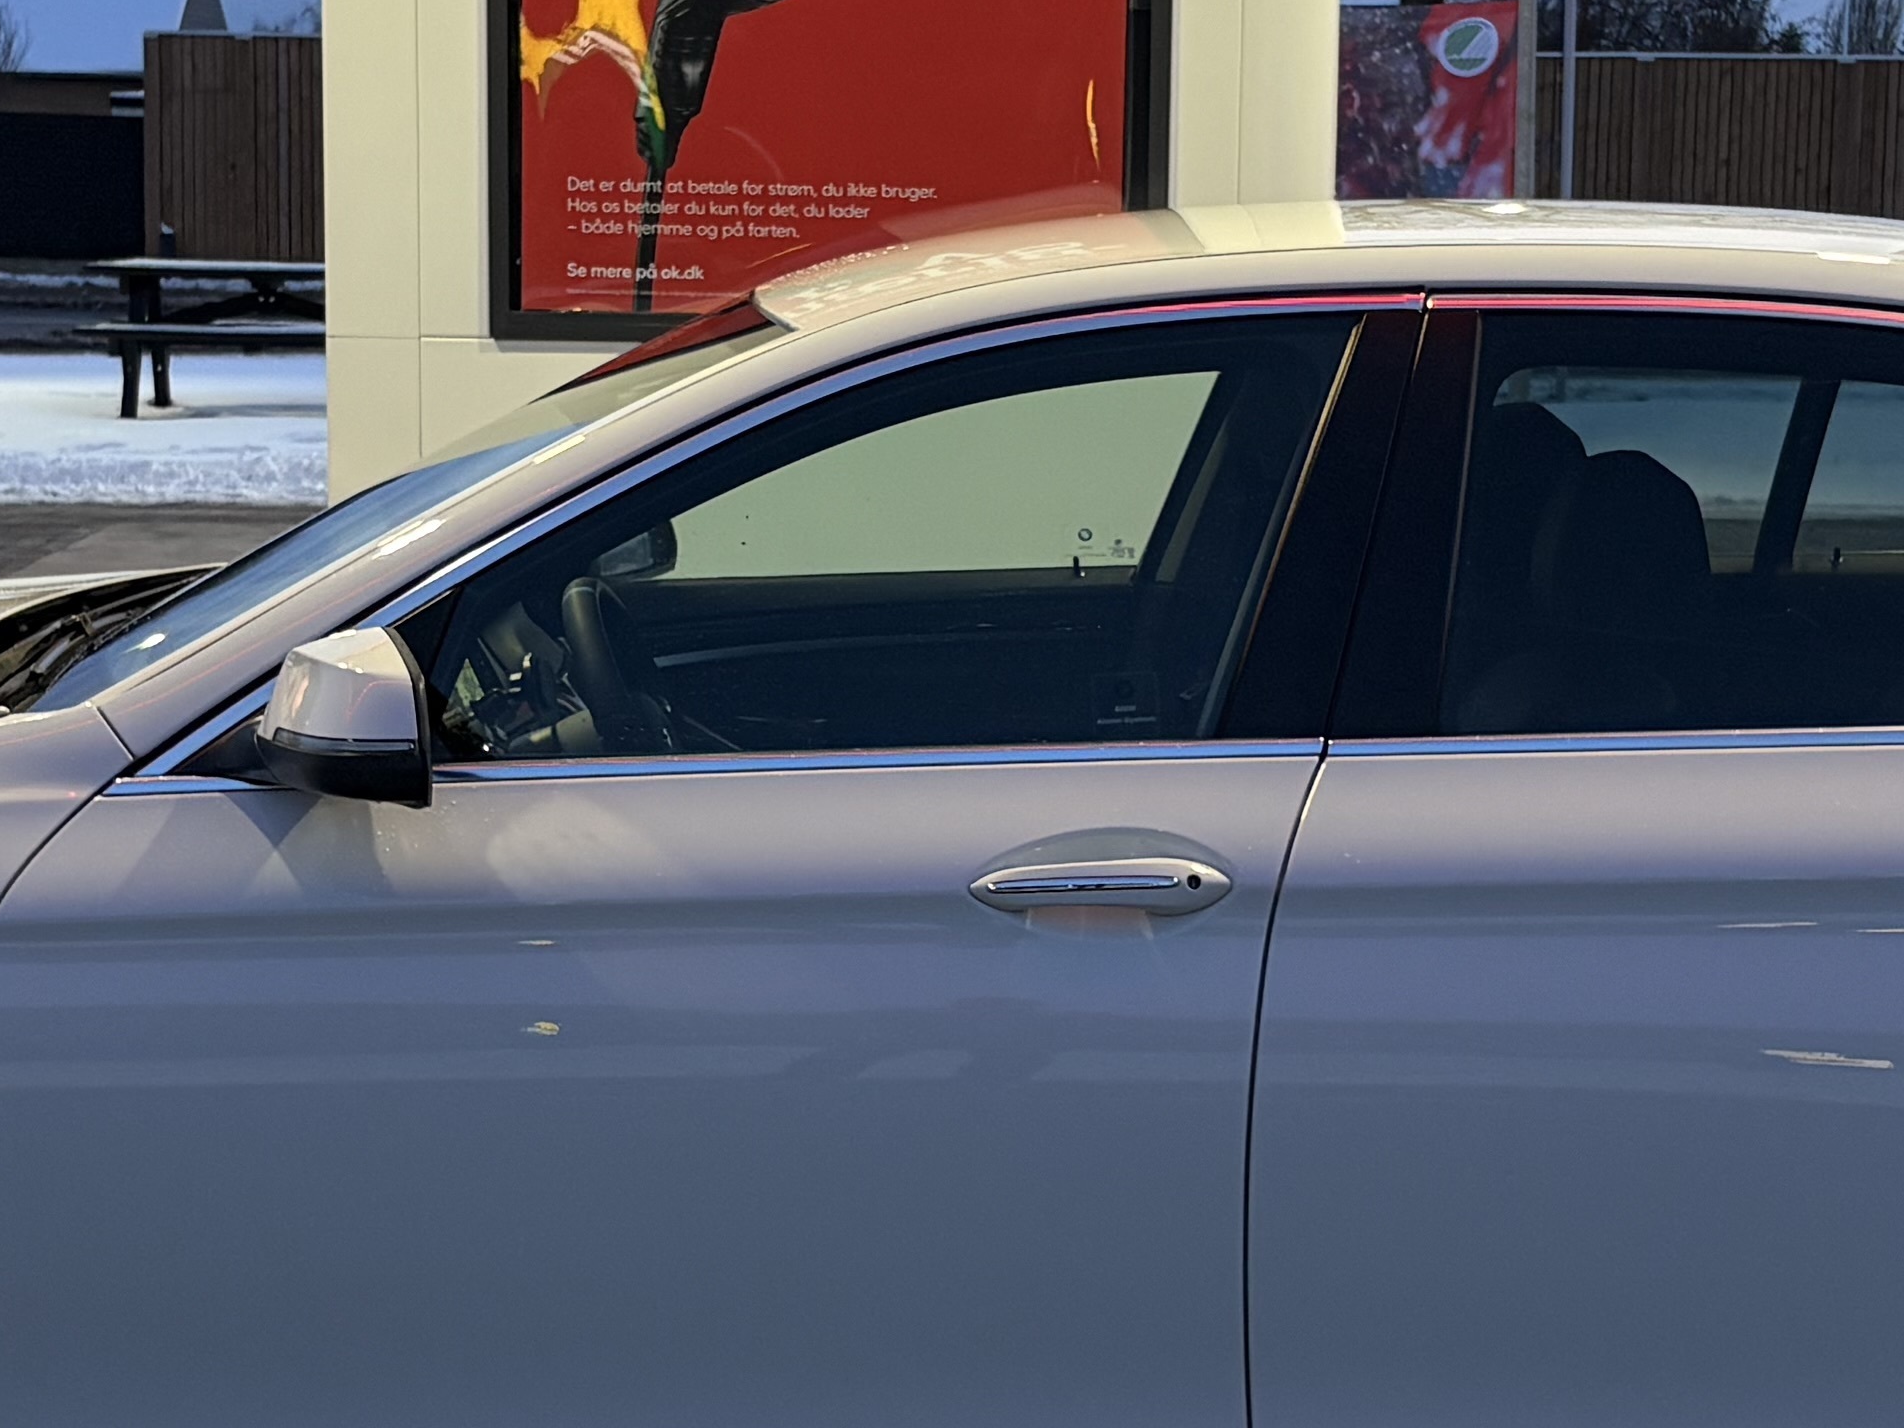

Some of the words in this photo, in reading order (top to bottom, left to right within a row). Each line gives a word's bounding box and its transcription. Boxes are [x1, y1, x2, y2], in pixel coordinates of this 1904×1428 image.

[567, 176, 595, 192] Det
[599, 180, 616, 193] er
[620, 178, 662, 194] dumt
[666, 180, 684, 194] at
[688, 180, 738, 195] betale
[742, 180, 764, 196] for
[768, 182, 818, 198] strøm,
[822, 182, 844, 197] du
[847, 182, 877, 198] ikke
[881, 184, 938, 202] bruger.
[567, 198, 598, 213] Hos
[602, 202, 621, 213] os
[624, 200, 679, 215] betaler
[684, 201, 706, 215] du
[710, 201, 739, 216] kun
[743, 201, 765, 216] for
[803, 203, 825, 218] du
[829, 204, 870, 219] lader
[581, 218, 624, 234] både
[627, 221, 693, 238] hjemme
[696, 225, 718, 240] og
[722, 220, 745, 240] på
[748, 223, 800, 239] farten.
[567, 262, 587, 278] Se
[590, 266, 633, 279] mere
[635, 262, 657, 282] på
[660, 265, 705, 280] ok.dk
